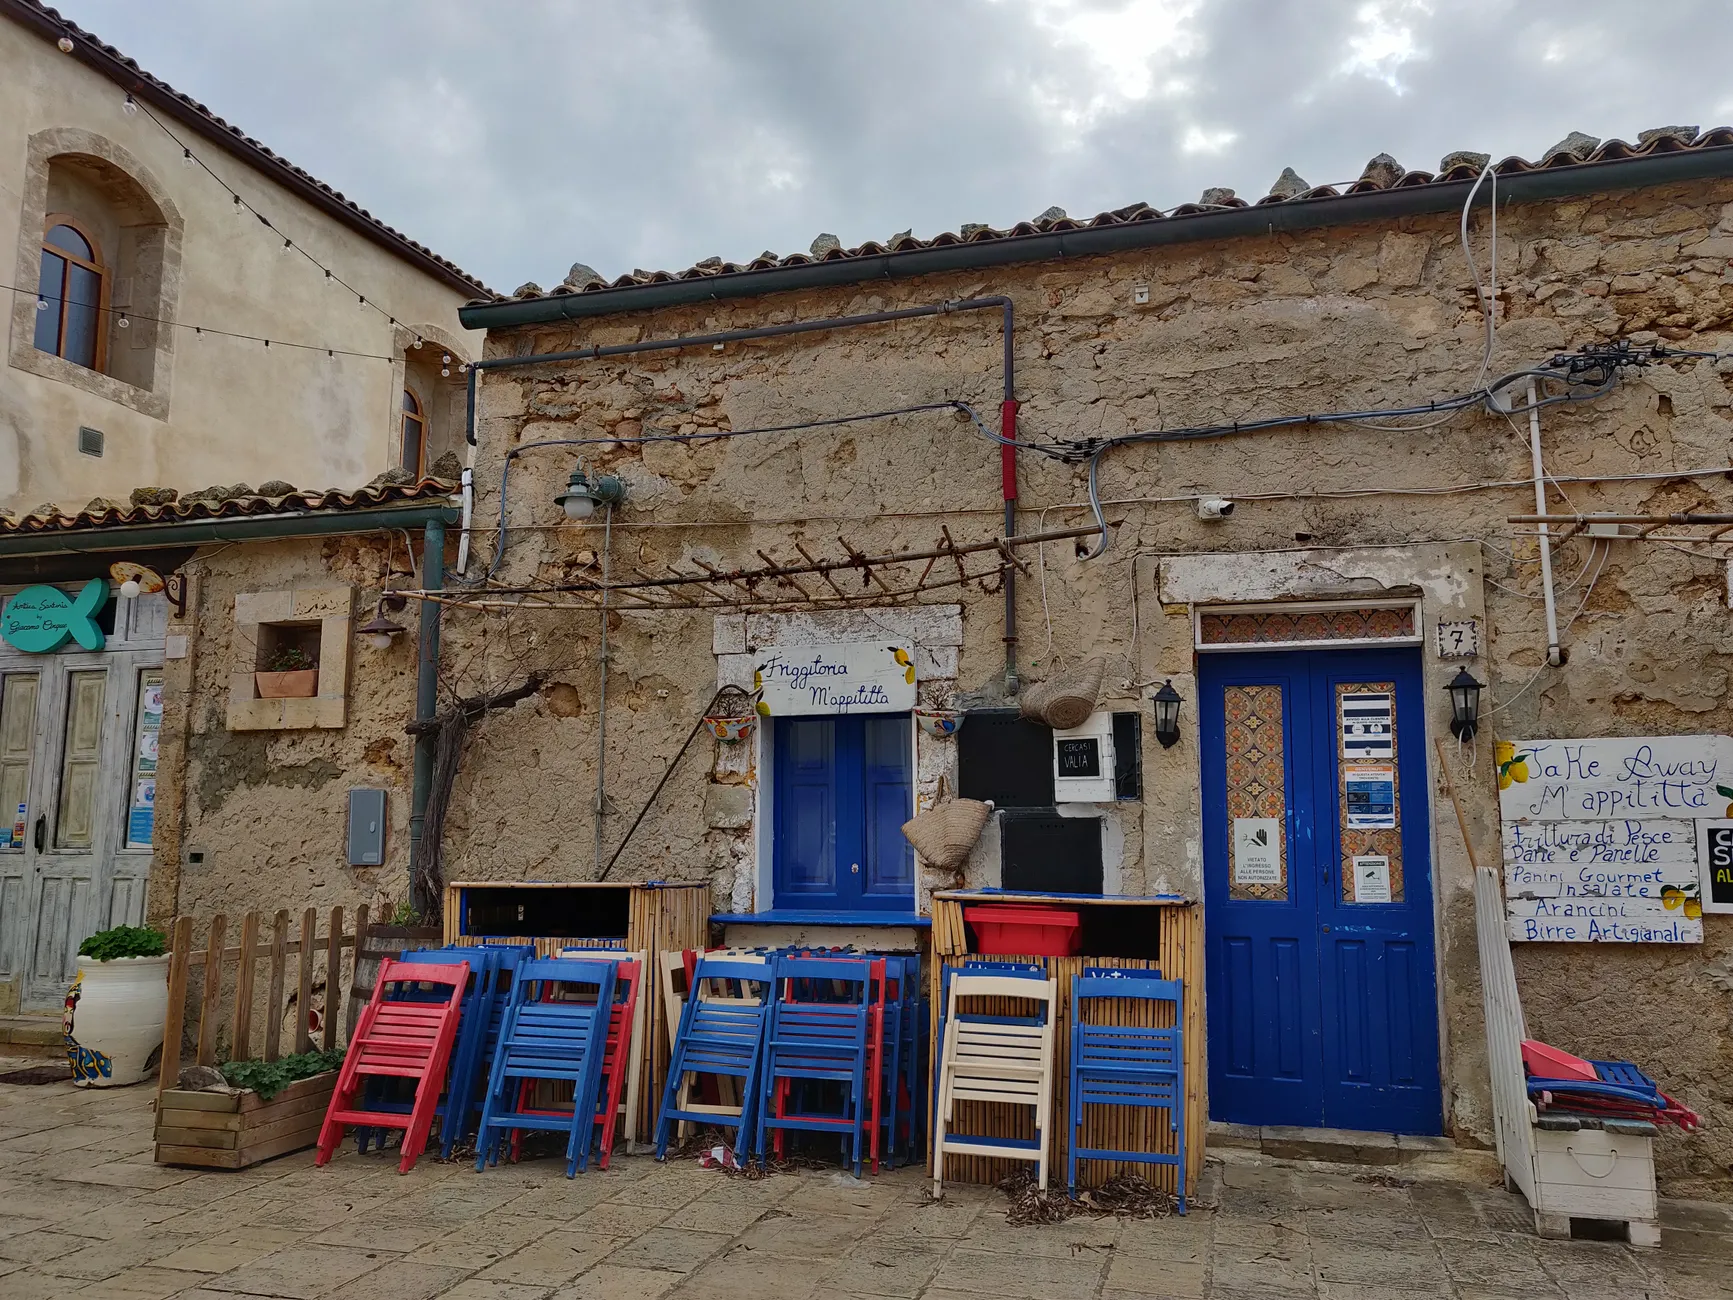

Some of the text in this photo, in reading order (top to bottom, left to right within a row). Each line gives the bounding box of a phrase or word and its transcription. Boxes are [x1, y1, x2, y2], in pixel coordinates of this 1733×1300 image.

[1450, 630, 1464, 650] 7
[766, 654, 849, 690] Friggitoria
[809, 684, 890, 714] M'appititta
[1616, 745, 1718, 785] Away
[1509, 820, 1673, 849] Frittura di Pesce
[1715, 829, 1733, 846] C
[1569, 849, 1580, 862] e
[1589, 843, 1660, 863] Panelle
[1713, 845, 1733, 866] S
[1512, 865, 1663, 884] Panini Gourmet
[1557, 882, 1650, 898] Insalate
[1535, 897, 1627, 917] Arancini
[1523, 918, 1691, 943] Birre Artigianali
